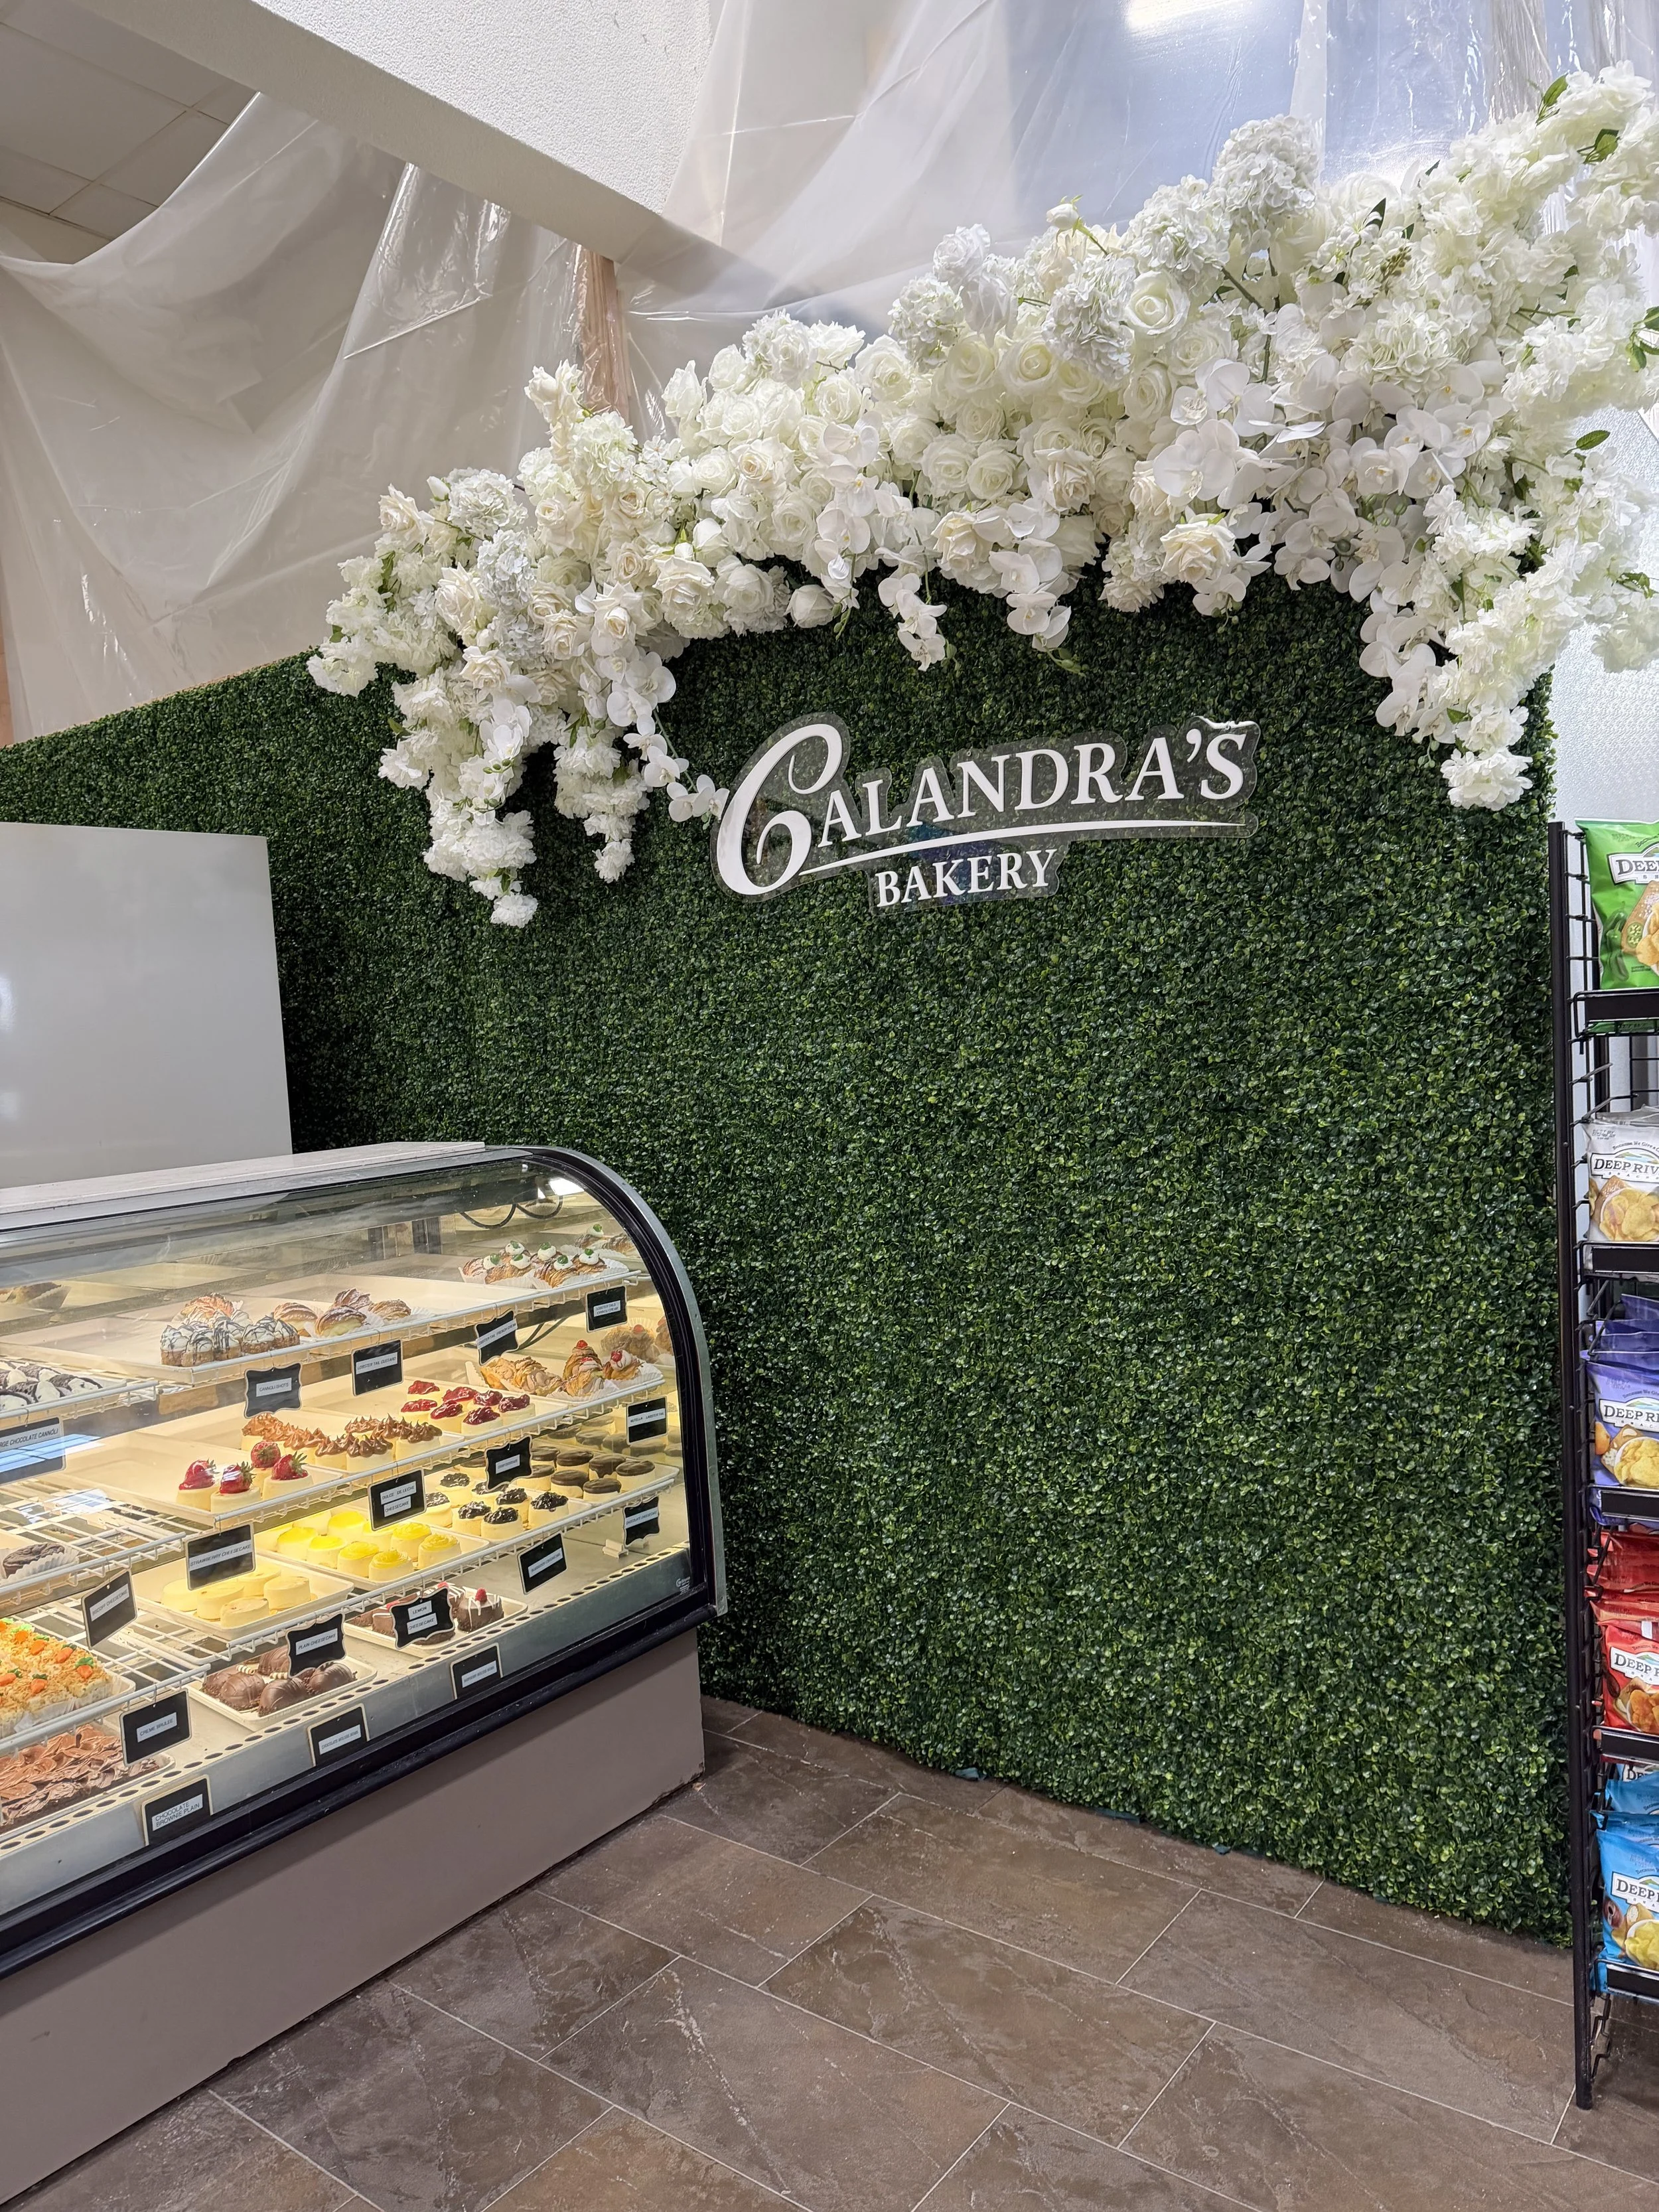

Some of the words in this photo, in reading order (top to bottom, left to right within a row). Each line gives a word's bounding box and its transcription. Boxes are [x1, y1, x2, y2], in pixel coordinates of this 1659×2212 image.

[717, 723, 1246, 896] CALANDRA'S
[1615, 859, 1659, 875] DEE
[875, 849, 1057, 908] BAKERY
[1593, 1158, 1631, 1171] DEEP
[1604, 1404, 1643, 1420] DEEP
[9, 1433, 38, 1445] CHOCOLATE
[38, 1428, 58, 1438] CANNOLI
[385, 1501, 409, 1513] CHEESECAKE
[190, 1553, 221, 1567] STRAWBERRY
[221, 1544, 252, 1557] CHEESECAKE
[412, 1606, 427, 1615] LEMON
[408, 1617, 435, 1630] CHEESECAKE
[310, 1633, 336, 1645] CHEESECAKE
[1614, 1653, 1652, 1674] DEEP
[155, 1801, 190, 1821] CHOCOLATE
[156, 1810, 183, 1827] BROWNIE
[183, 1802, 200, 1814] PLAIN
[1616, 1878, 1655, 1900] DEEP
